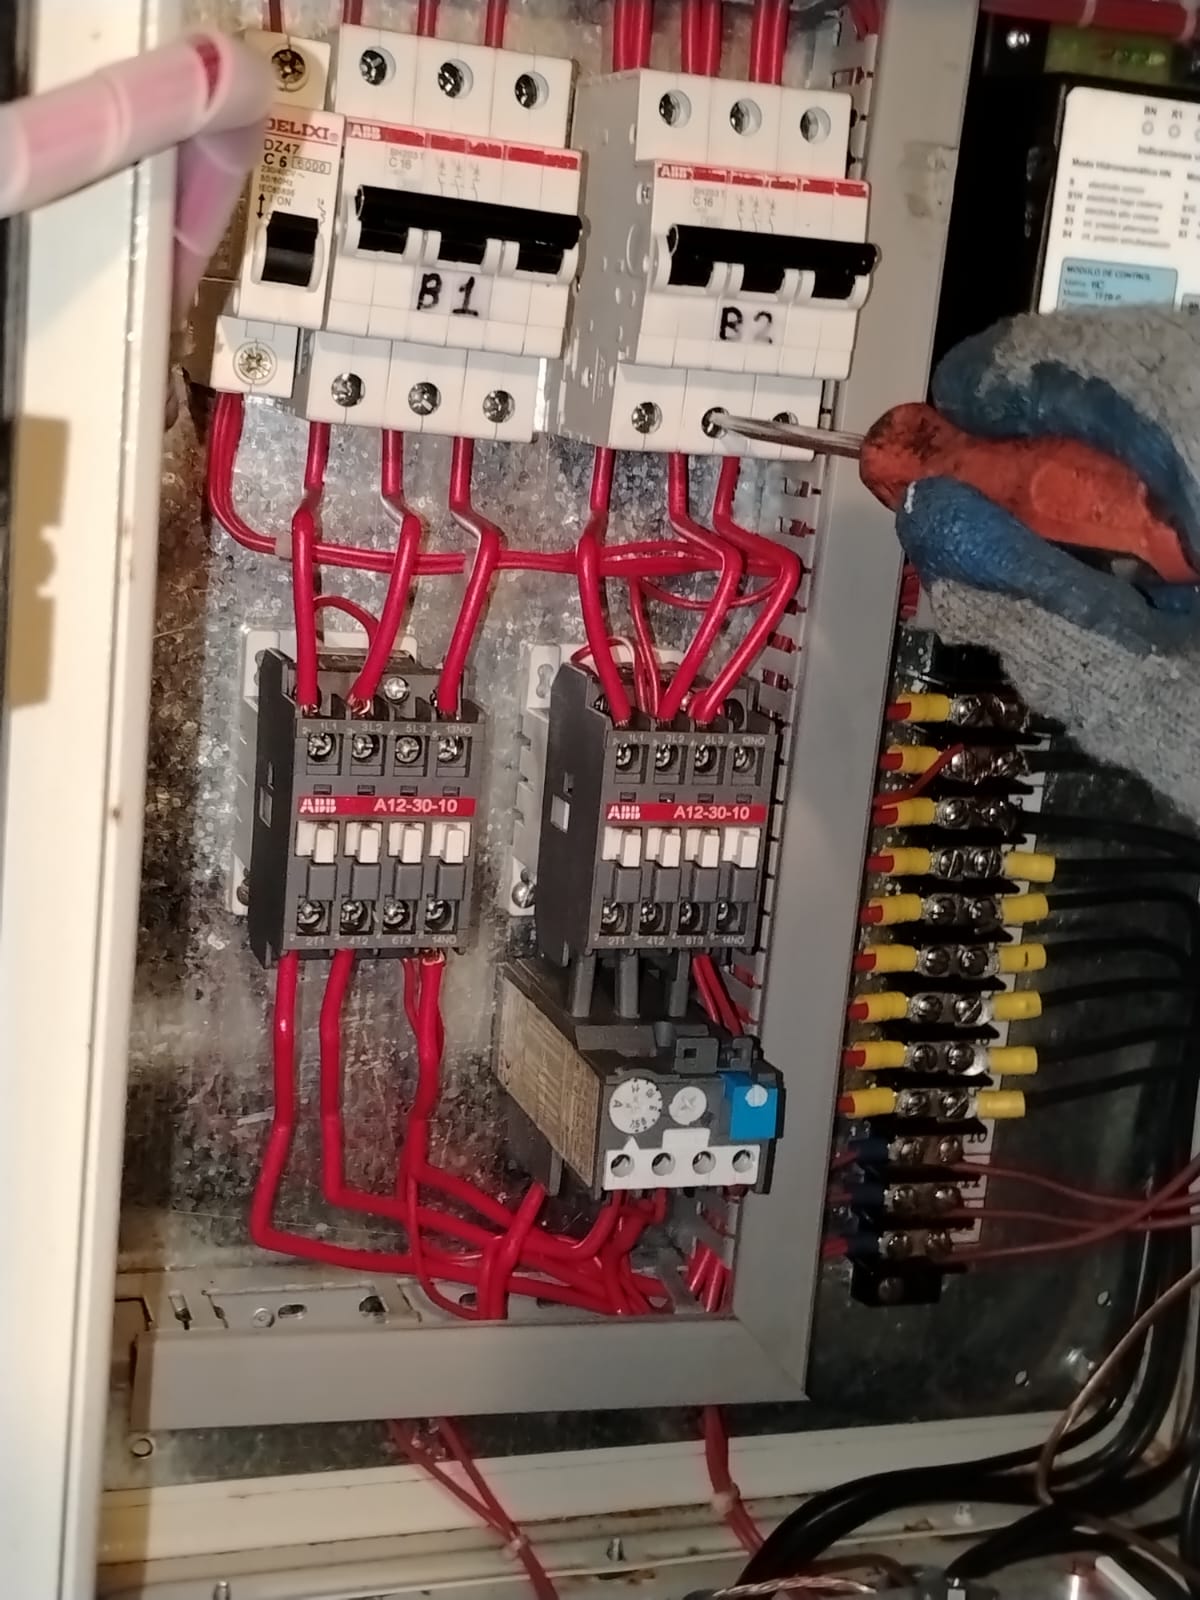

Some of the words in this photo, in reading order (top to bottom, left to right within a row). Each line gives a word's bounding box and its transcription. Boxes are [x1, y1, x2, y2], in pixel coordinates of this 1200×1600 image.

[350, 123, 381, 140] ABB
[264, 139, 300, 154] DZ47
[279, 156, 288, 168] 6
[660, 164, 687, 179] ABB
[361, 723, 384, 733] 3L2
[405, 724, 426, 733] 5L3
[300, 798, 337, 814] ABB
[373, 798, 458, 813] A12-30-10
[607, 805, 641, 820] ABB
[673, 805, 750, 820] A12-30-10
